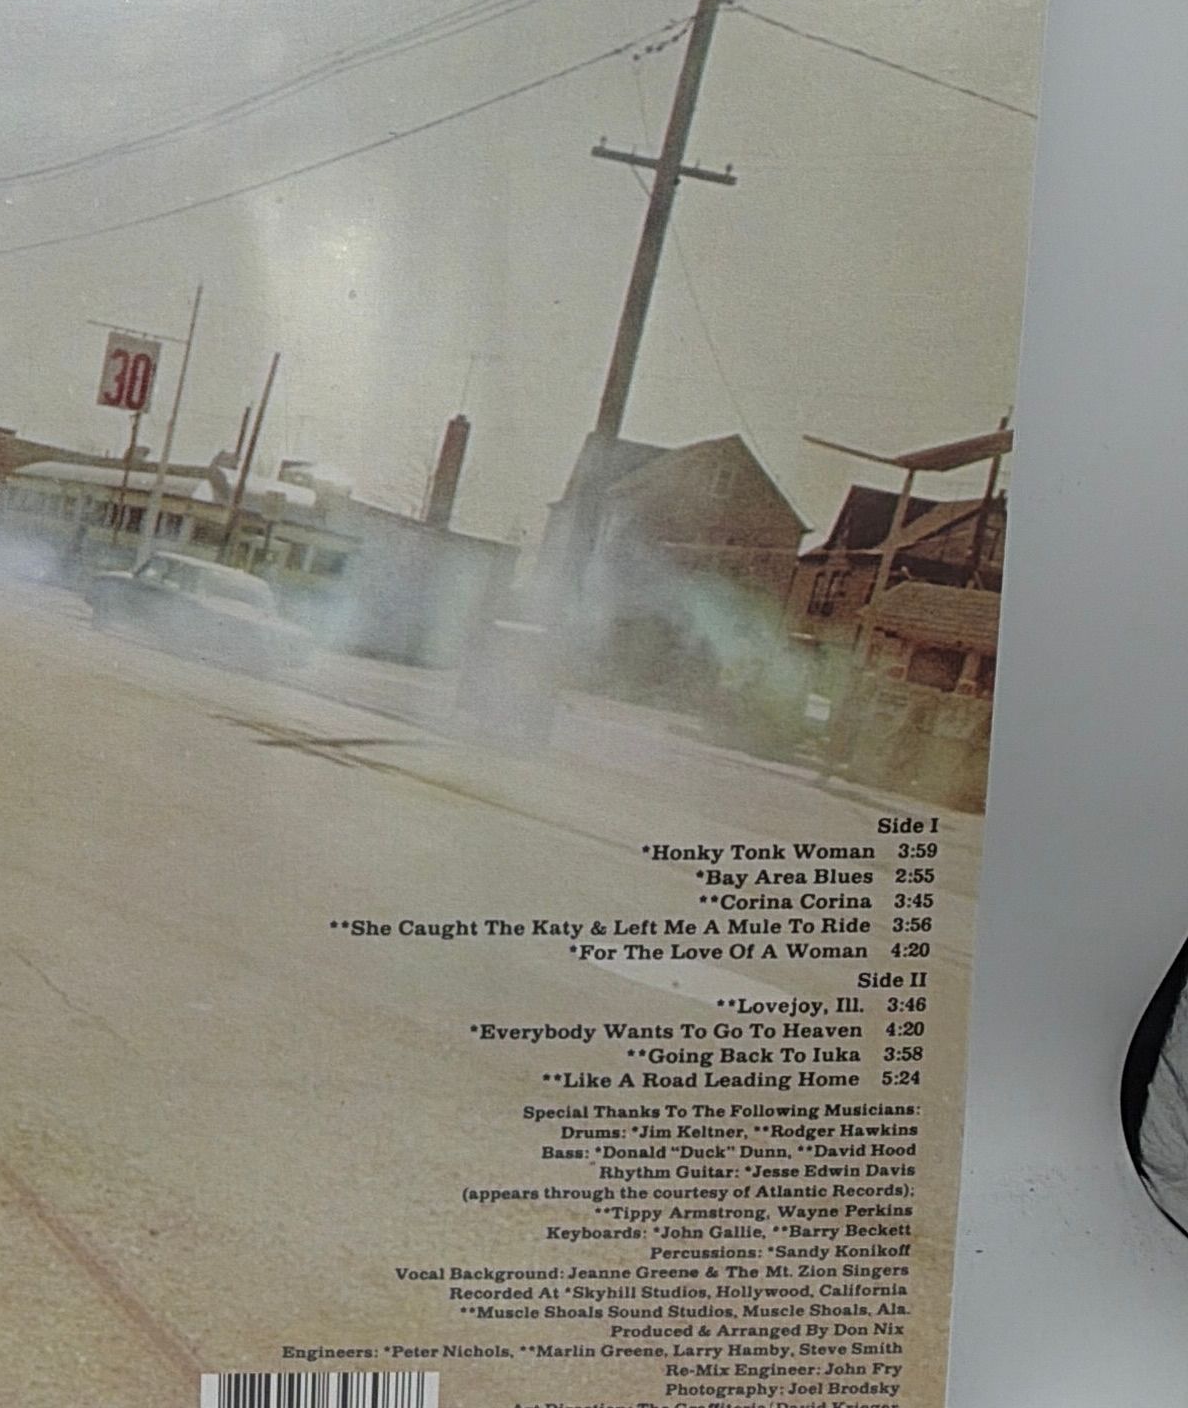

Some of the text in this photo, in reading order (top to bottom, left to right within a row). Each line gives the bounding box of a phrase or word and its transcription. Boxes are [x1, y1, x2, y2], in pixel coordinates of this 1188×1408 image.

[104, 348, 153, 410] 30
[878, 817, 938, 834] Side I
[730, 844, 785, 860] Tonk
[793, 843, 875, 859] Woman
[898, 843, 937, 858] 3:59
[754, 869, 807, 885] Area
[813, 868, 873, 884] Blues
[895, 868, 935, 883] 2:55
[800, 893, 872, 909] Corina
[894, 893, 934, 908] 3:45
[398, 920, 478, 940] Caught
[484, 920, 525, 937] The
[532, 920, 583, 940] Katy
[590, 921, 607, 936] &
[613, 919, 657, 935] Left
[664, 919, 697, 935] Me
[703, 920, 720, 935] A
[727, 918, 782, 934] Mule
[788, 918, 815, 934] To
[821, 917, 871, 933] Ride
[892, 917, 932, 932] 3:56
[624, 943, 664, 960] The
[670, 944, 723, 960] Love
[729, 944, 755, 960] Of
[761, 944, 778, 959] A
[786, 943, 867, 959] Woman
[891, 942, 930, 958] 4:20
[857, 972, 927, 988] Side II
[836, 997, 864, 1013] Ill.
[887, 997, 926, 1012] 3:46
[603, 1024, 673, 1040] Wants
[680, 1024, 707, 1039] To
[713, 1023, 743, 1039] Go
[749, 1022, 776, 1039] To
[782, 1023, 862, 1038] Heaven
[886, 1021, 924, 1036] 4:20
[720, 1048, 773, 1063] Back
[780, 1048, 806, 1063] To
[812, 1047, 861, 1062] Iuka
[884, 1046, 923, 1062] 3:58
[618, 1073, 635, 1088] A
[642, 1072, 697, 1088] Road
[705, 1071, 792, 1091] Leading
[798, 1072, 859, 1087] Home
[882, 1071, 920, 1086] 5:24
[523, 1103, 920, 1122] Special Thanks To The Following Musicians:
[561, 1126, 626, 1139] Drums:
[676, 1125, 748, 1141] Keltner,
[840, 1123, 918, 1136] Hawkins
[599, 1166, 670, 1182] Rhythm
[676, 1165, 739, 1178] Guitar:
[804, 1165, 860, 1177] Edwin
[866, 1163, 915, 1177] Davis
[463, 1187, 539, 1203] (appears
[544, 1186, 615, 1203] through
[620, 1186, 648, 1199] the
[653, 1187, 728, 1201] courtesy
[733, 1185, 751, 1198] of
[755, 1185, 827, 1198] Atlantic
[778, 1205, 838, 1221] Wayne
[845, 1204, 912, 1217] Perkins
[546, 1227, 646, 1243] Keyboards:
[709, 1225, 766, 1240] Gallie,
[845, 1223, 911, 1237] Beckett
[650, 1247, 762, 1259] Percussions:
[835, 1244, 911, 1257] Konikoff
[395, 1264, 909, 1283] Vocal Background: Jeanne Greene & The Mt. Zion Singers
[450, 1287, 533, 1300] Recorded
[538, 1287, 559, 1299] At
[641, 1286, 711, 1300] Studios,
[819, 1283, 907, 1296] California
[610, 1323, 904, 1340] Produced & Arranged By Don Nix
[666, 1363, 902, 1379] Re-Mix Engineer: John Fry
[665, 1382, 900, 1398] Photography: Joel Brodsky
